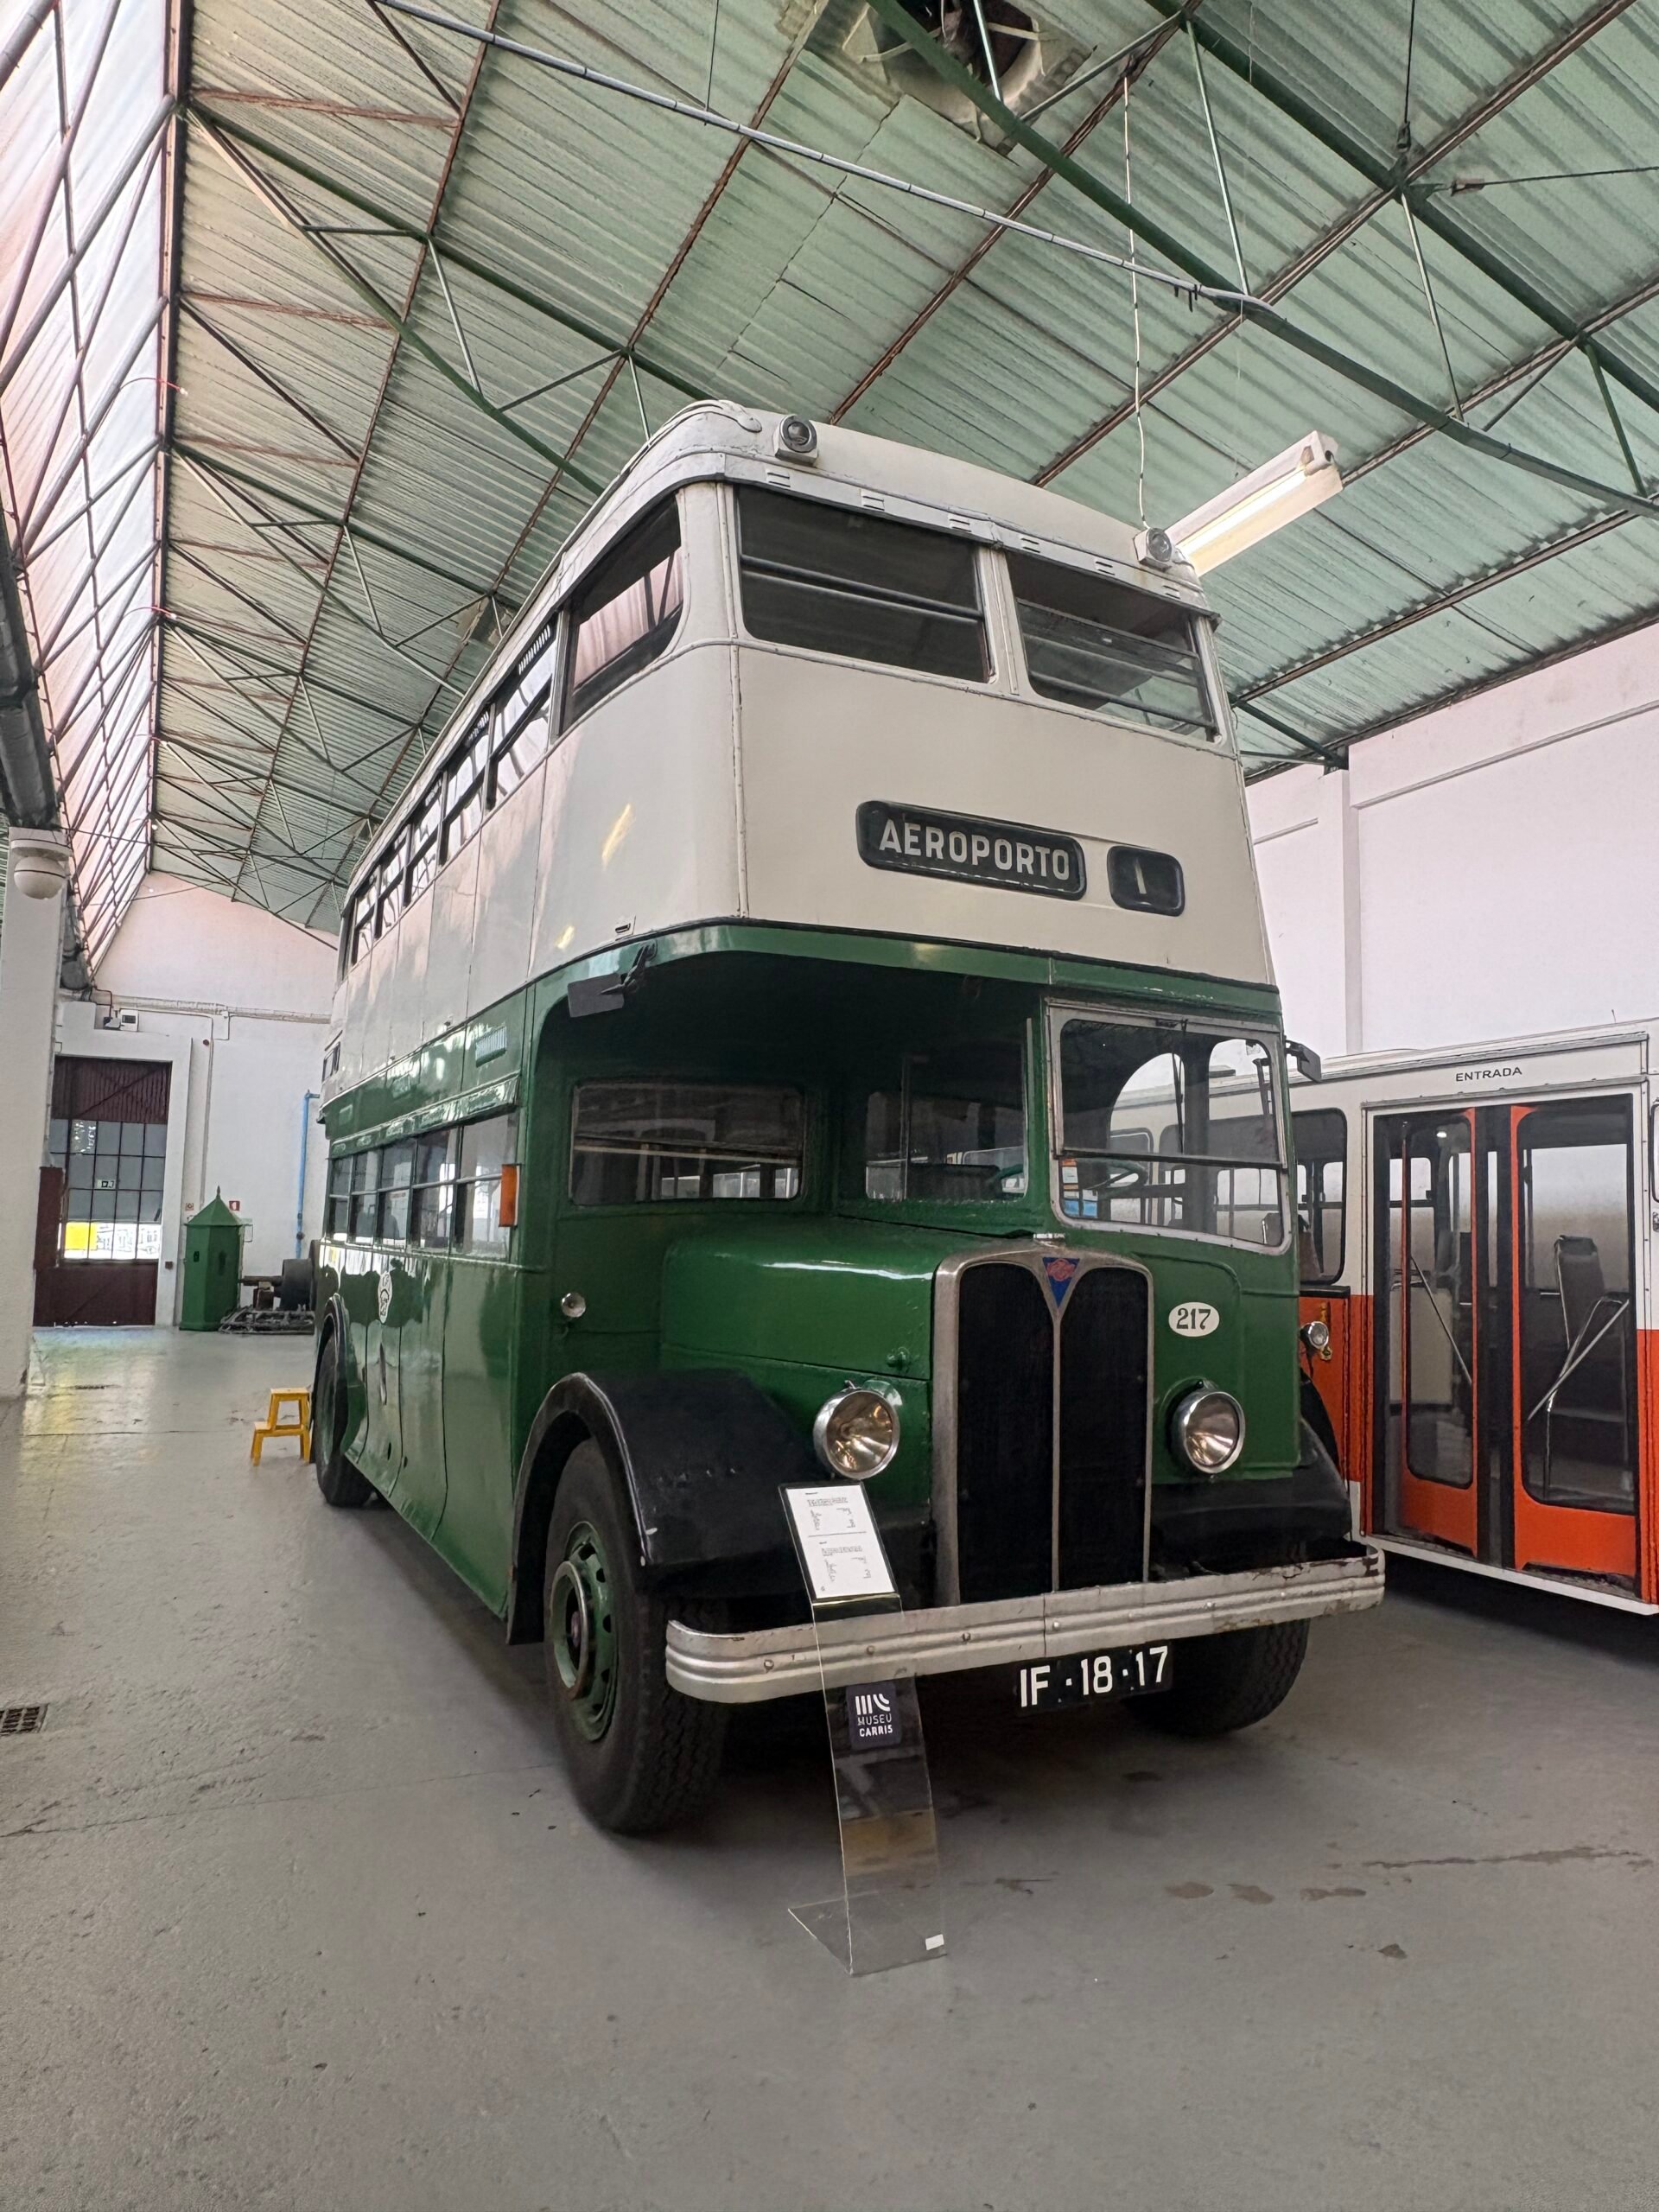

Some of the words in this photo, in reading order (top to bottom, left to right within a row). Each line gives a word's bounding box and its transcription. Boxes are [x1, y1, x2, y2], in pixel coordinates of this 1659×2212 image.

[879, 819, 1071, 881] AEROPORTO
[1455, 1066, 1522, 1082] ENTRADA
[1176, 1307, 1211, 1331] 217
[856, 1713, 893, 1726] MUSEU
[859, 1725, 893, 1738] CARRIS
